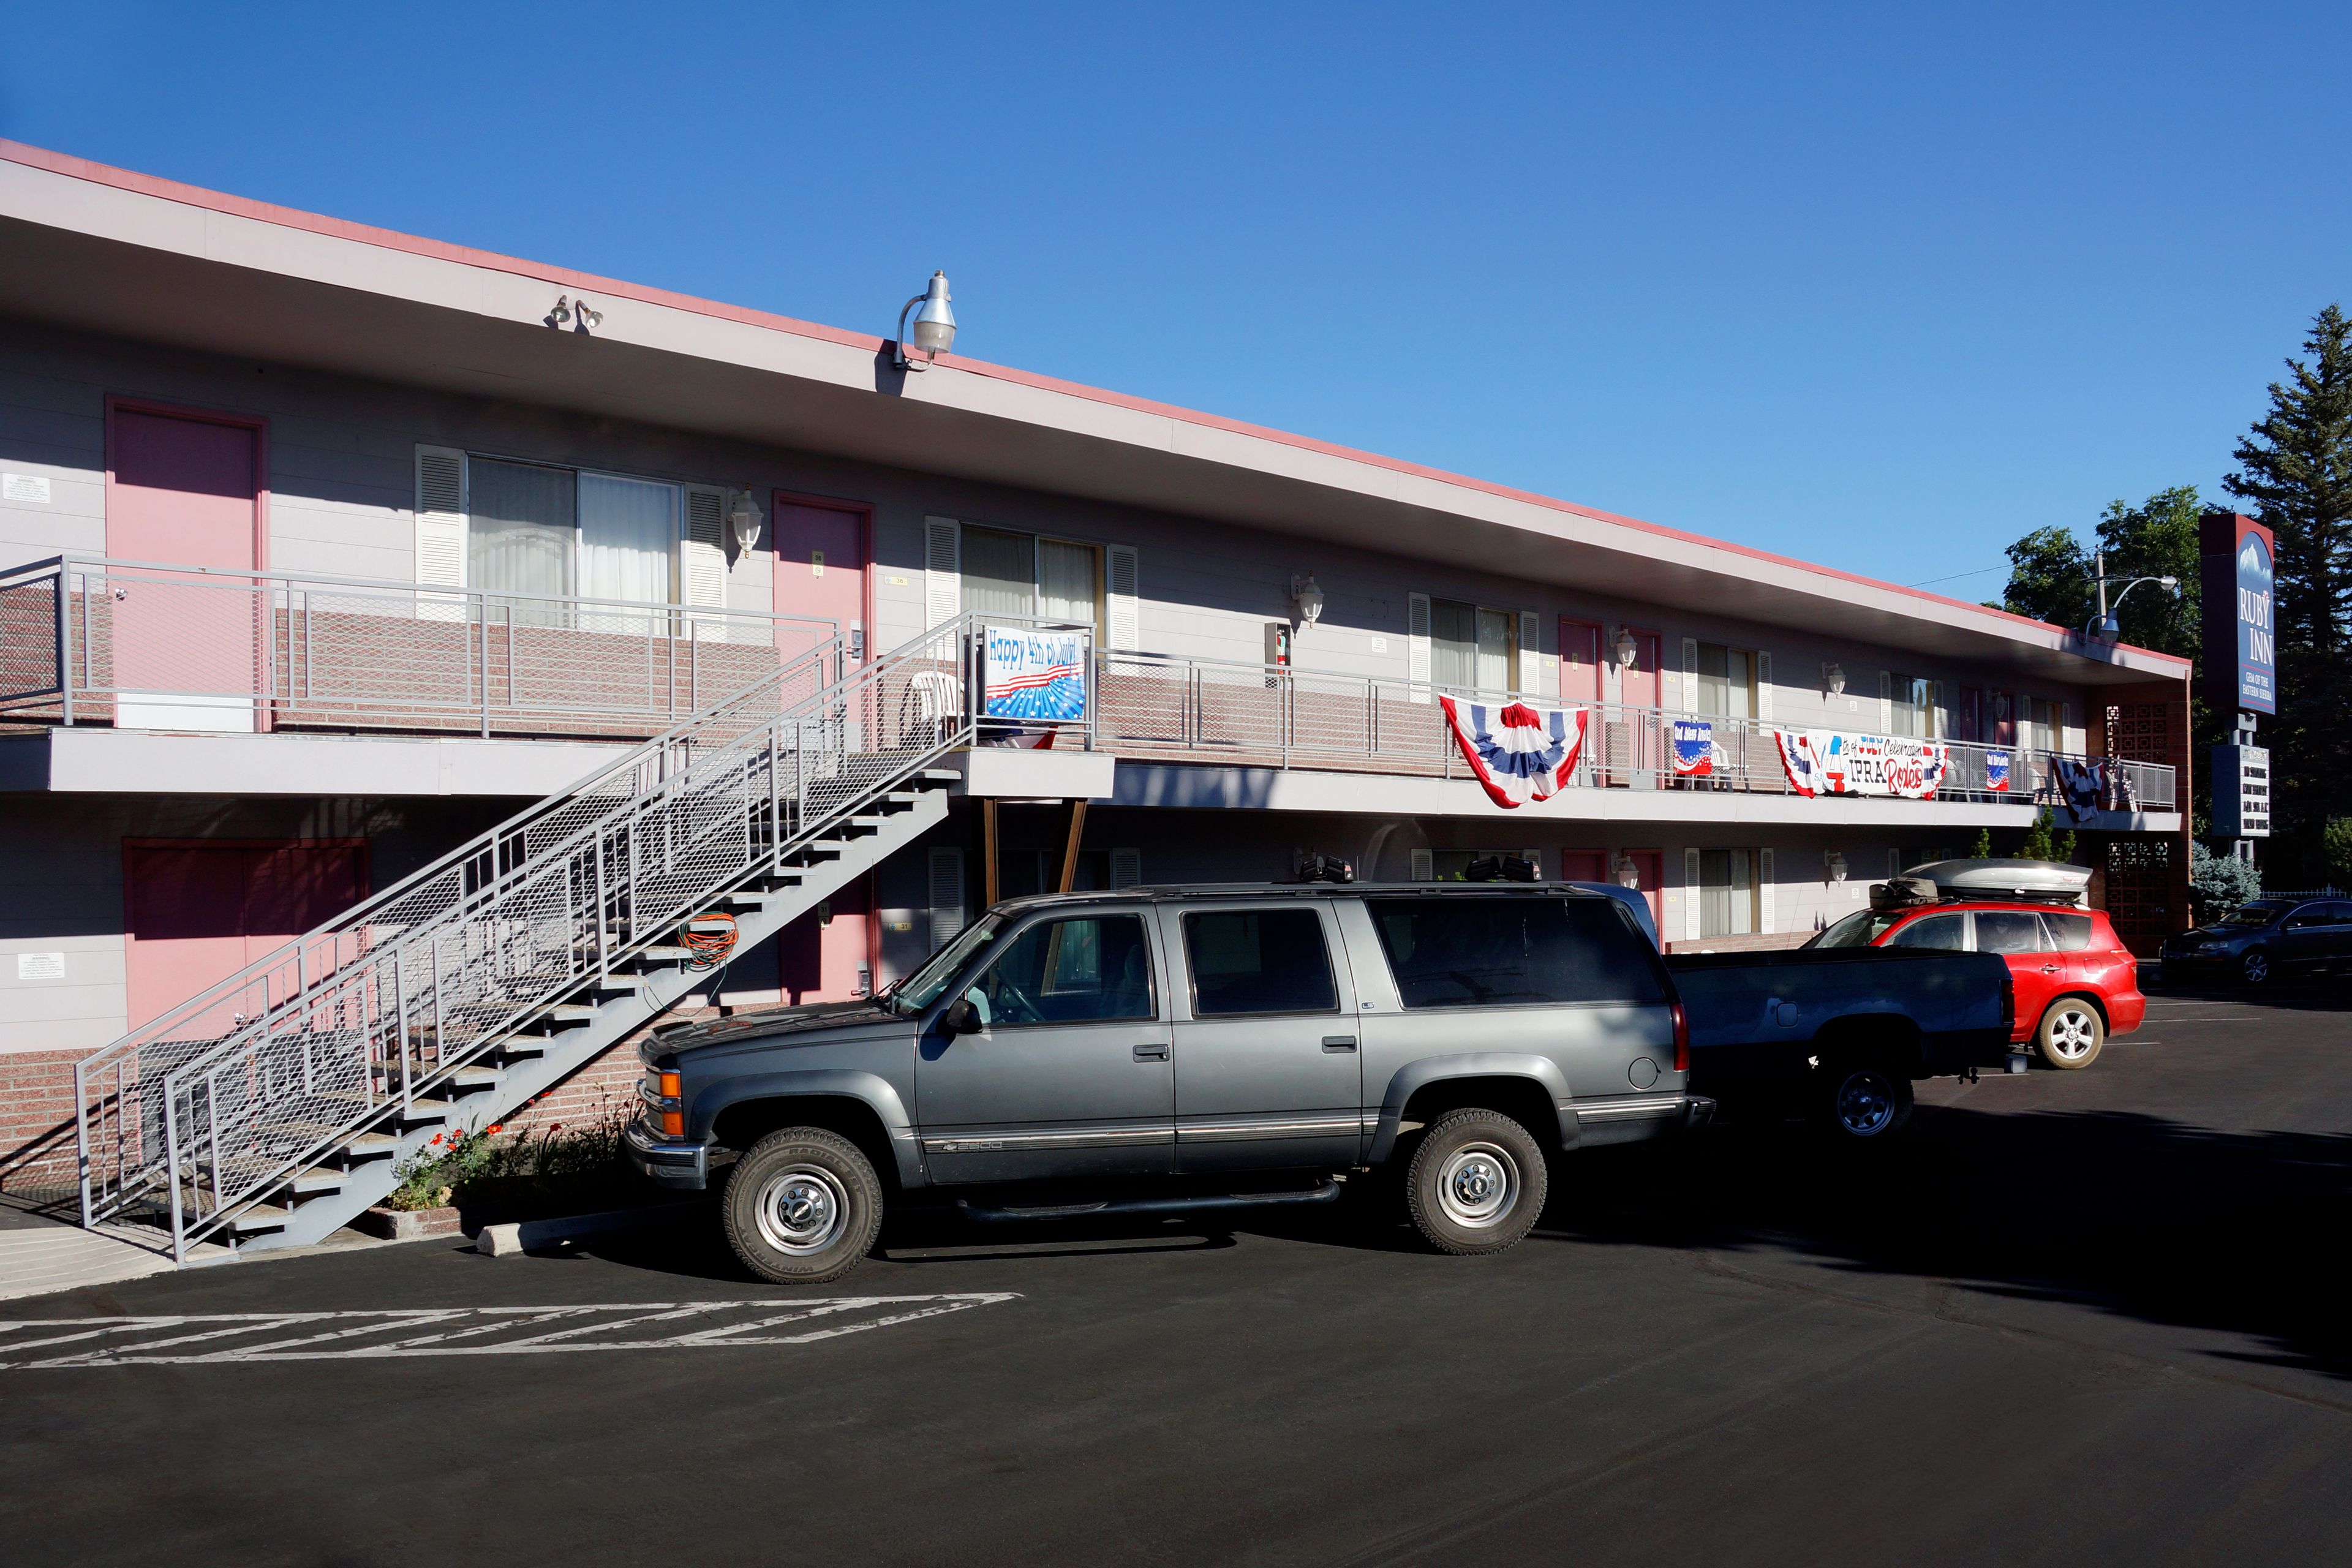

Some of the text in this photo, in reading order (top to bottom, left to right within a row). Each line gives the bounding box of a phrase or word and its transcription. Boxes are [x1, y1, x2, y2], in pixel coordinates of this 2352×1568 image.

[2239, 587, 2269, 629] RUBY
[989, 630, 1076, 674] Happy 4th of July!
[2250, 628, 2272, 666] INN
[2242, 684, 2272, 701] EASTERN SIERRA
[2245, 671, 2255, 683] GEM
[2255, 674, 2261, 685] OF
[1851, 738, 1857, 758] of
[1859, 736, 1883, 755] JULY
[1884, 739, 1923, 757] Celebration
[1849, 760, 1887, 783] IPRA
[1885, 758, 1923, 794] Rodeo
[788, 1148, 845, 1169] RADIAL
